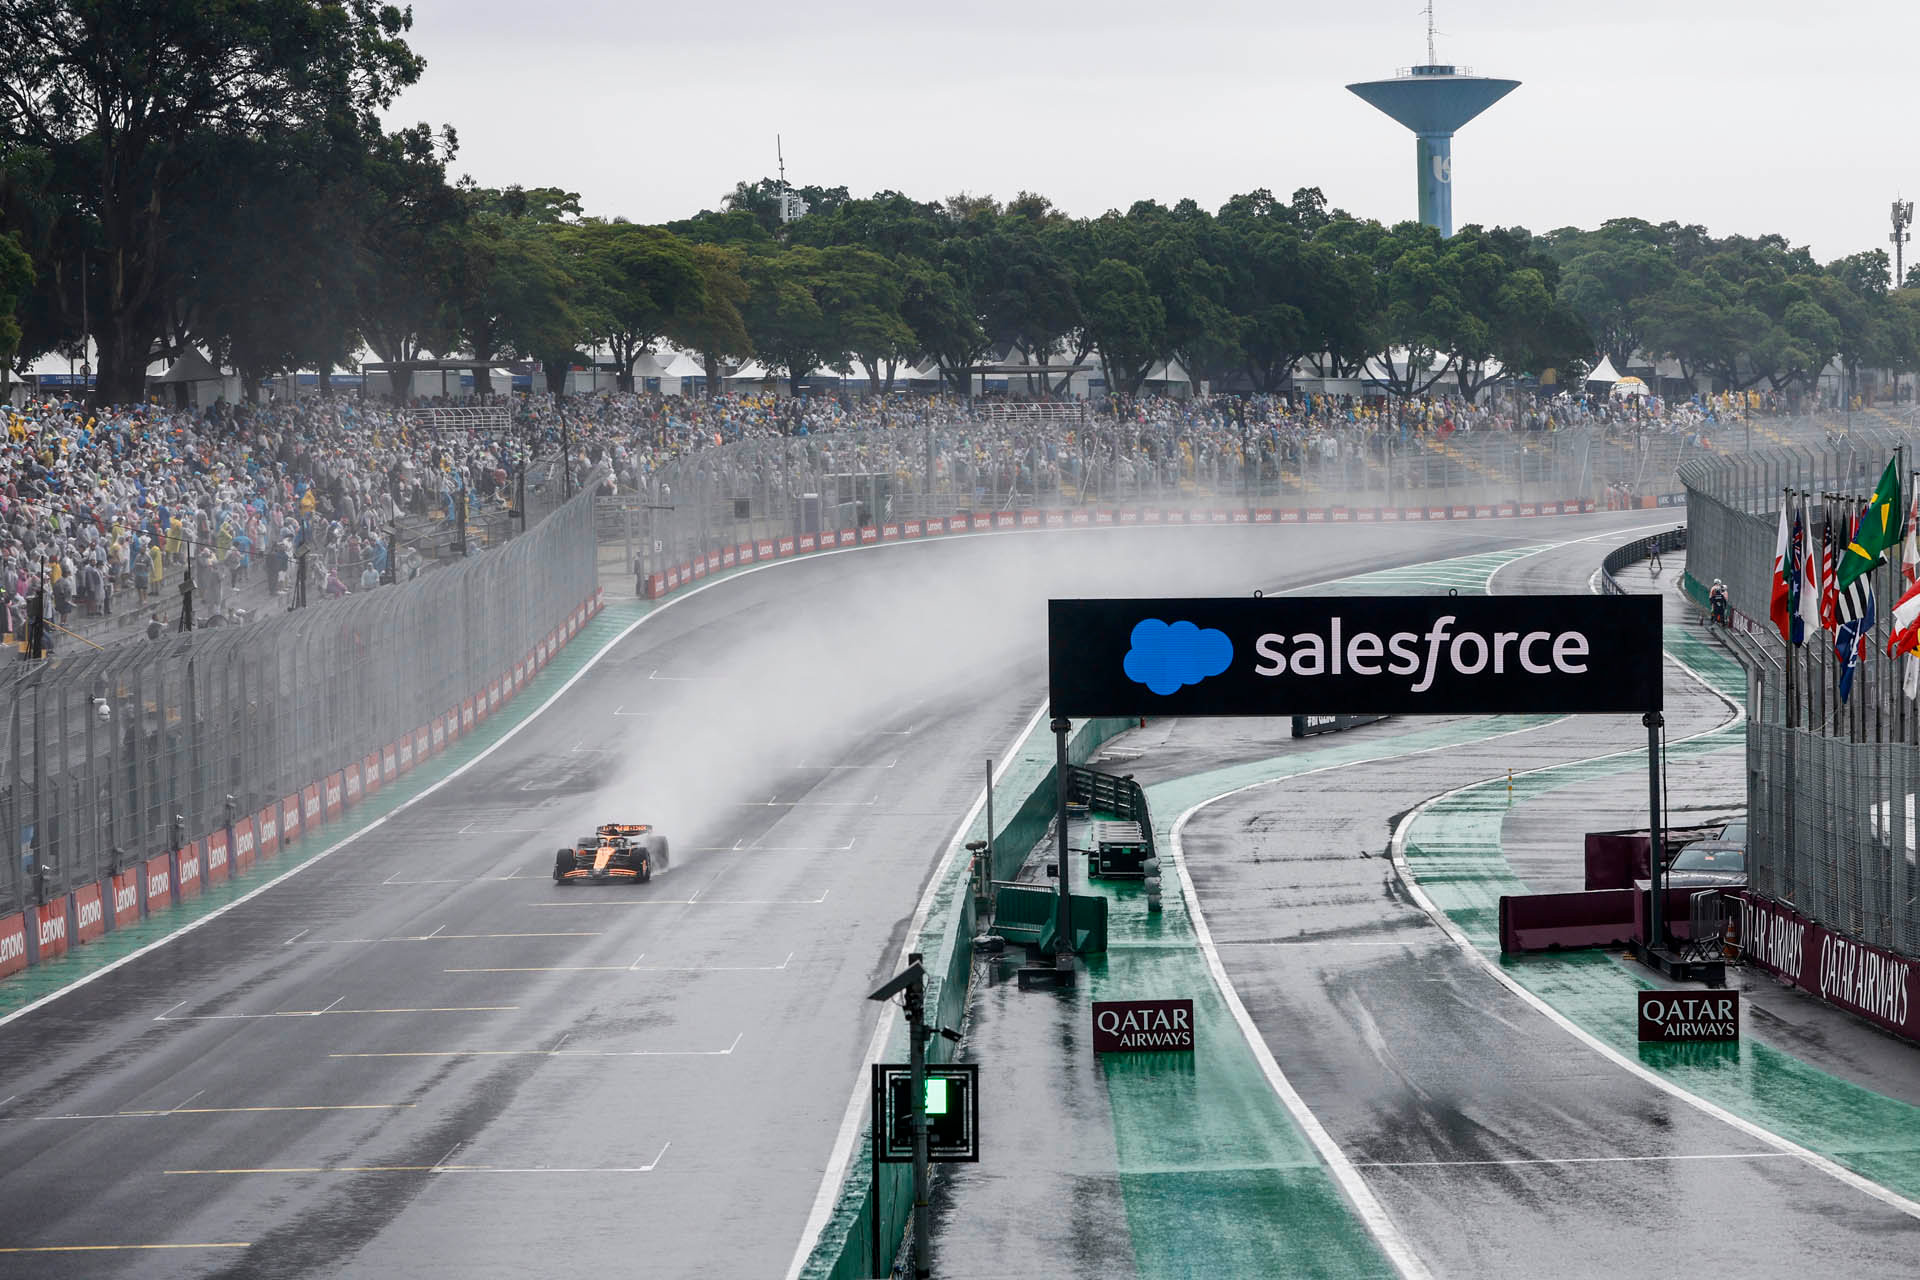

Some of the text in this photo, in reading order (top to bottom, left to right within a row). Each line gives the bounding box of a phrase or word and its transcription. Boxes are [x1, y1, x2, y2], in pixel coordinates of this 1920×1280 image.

[1255, 615, 1590, 693] salesforce
[208, 844, 227, 870] Lenovo
[236, 832, 253, 857] Lenovo
[179, 857, 199, 884] Lenovo
[114, 885, 136, 913] Lenovo
[149, 872, 168, 898] Lenovo
[77, 899, 101, 929] Lenovo
[38, 916, 65, 946] Lenovo
[0, 931, 24, 963] enovo
[1767, 912, 1805, 979] AIRWAYS
[1820, 934, 1909, 1026] QATAR AIRWAYS
[1097, 1008, 1190, 1037] QATAR
[1643, 999, 1734, 1026] QATAR
[1119, 1031, 1191, 1047] AIRWAYS
[1664, 1022, 1735, 1036] AIRWAYS
